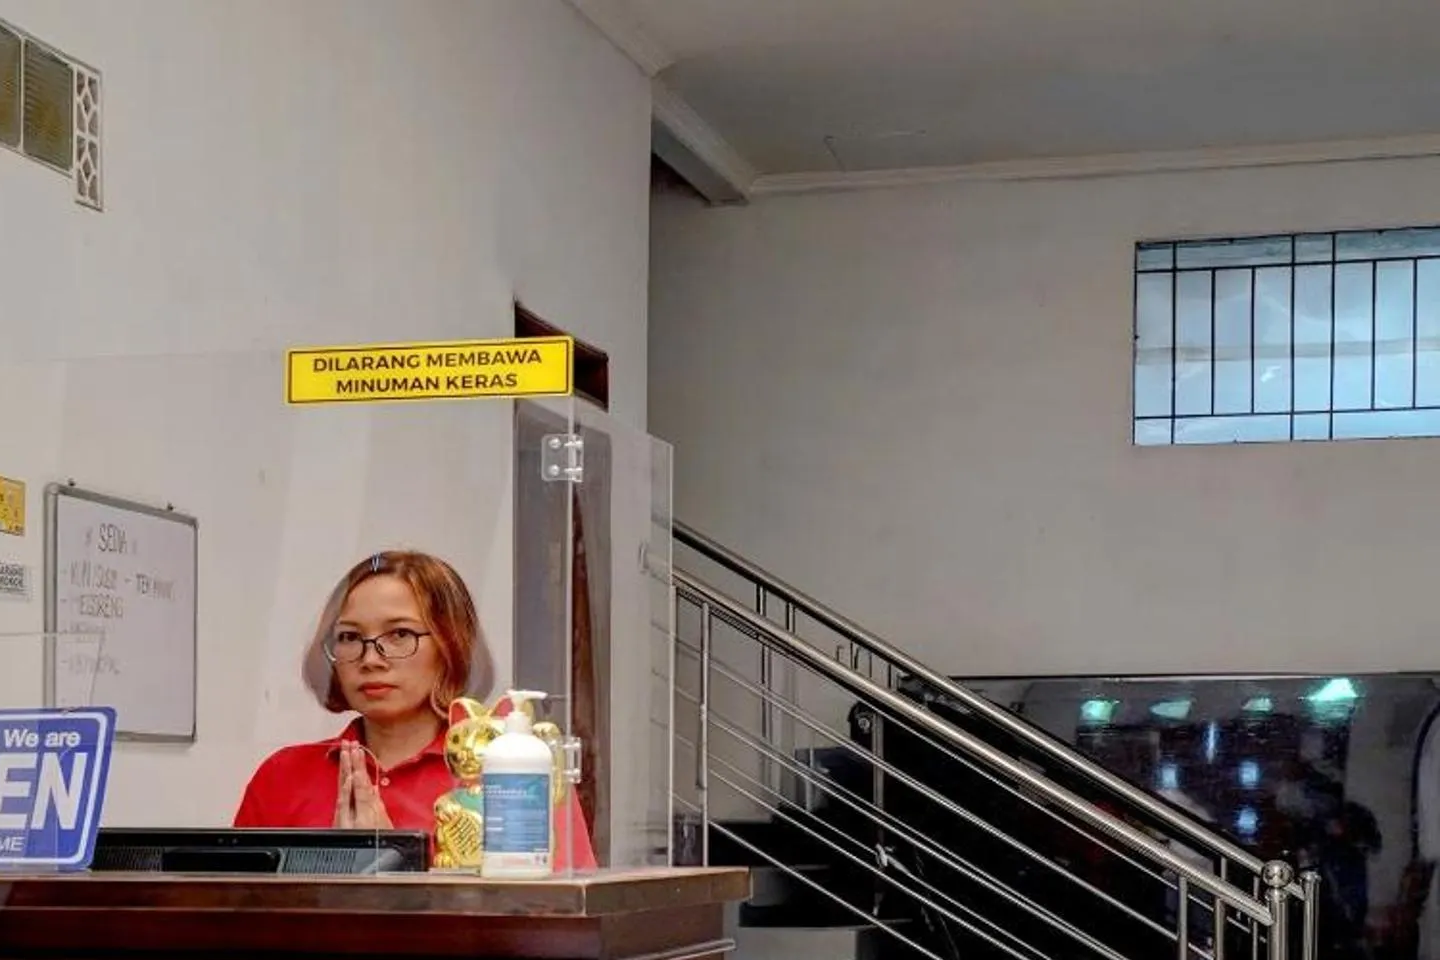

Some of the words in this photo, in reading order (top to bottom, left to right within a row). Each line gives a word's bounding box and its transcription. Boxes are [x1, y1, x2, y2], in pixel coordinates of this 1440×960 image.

[313, 353, 421, 373] DILARANG
[426, 349, 542, 368] MEMBAWA
[336, 376, 440, 394] MINUMAN
[446, 373, 518, 390] KERAS
[3, 728, 39, 748] We
[44, 731, 81, 748] are
